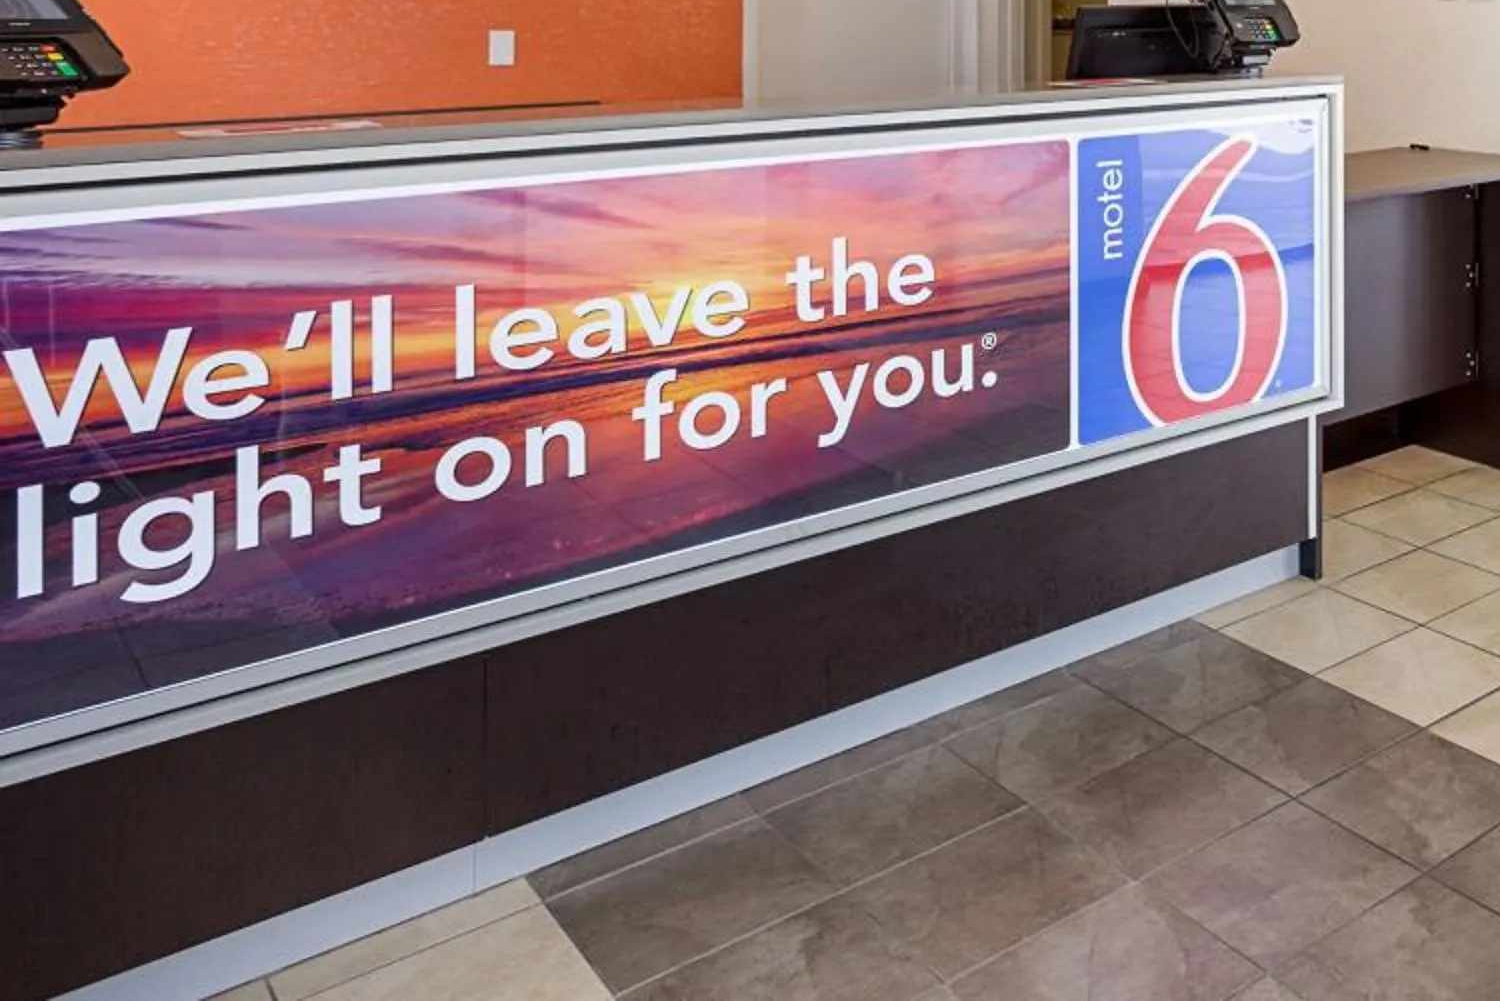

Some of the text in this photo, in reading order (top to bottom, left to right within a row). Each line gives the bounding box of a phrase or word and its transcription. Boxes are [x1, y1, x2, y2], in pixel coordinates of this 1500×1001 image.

[455, 283, 750, 380] leave
[785, 235, 936, 324] the
[1095, 132, 1289, 428] motel 6
[17, 444, 382, 603] light
[434, 419, 587, 503] on
[631, 369, 787, 462] for
